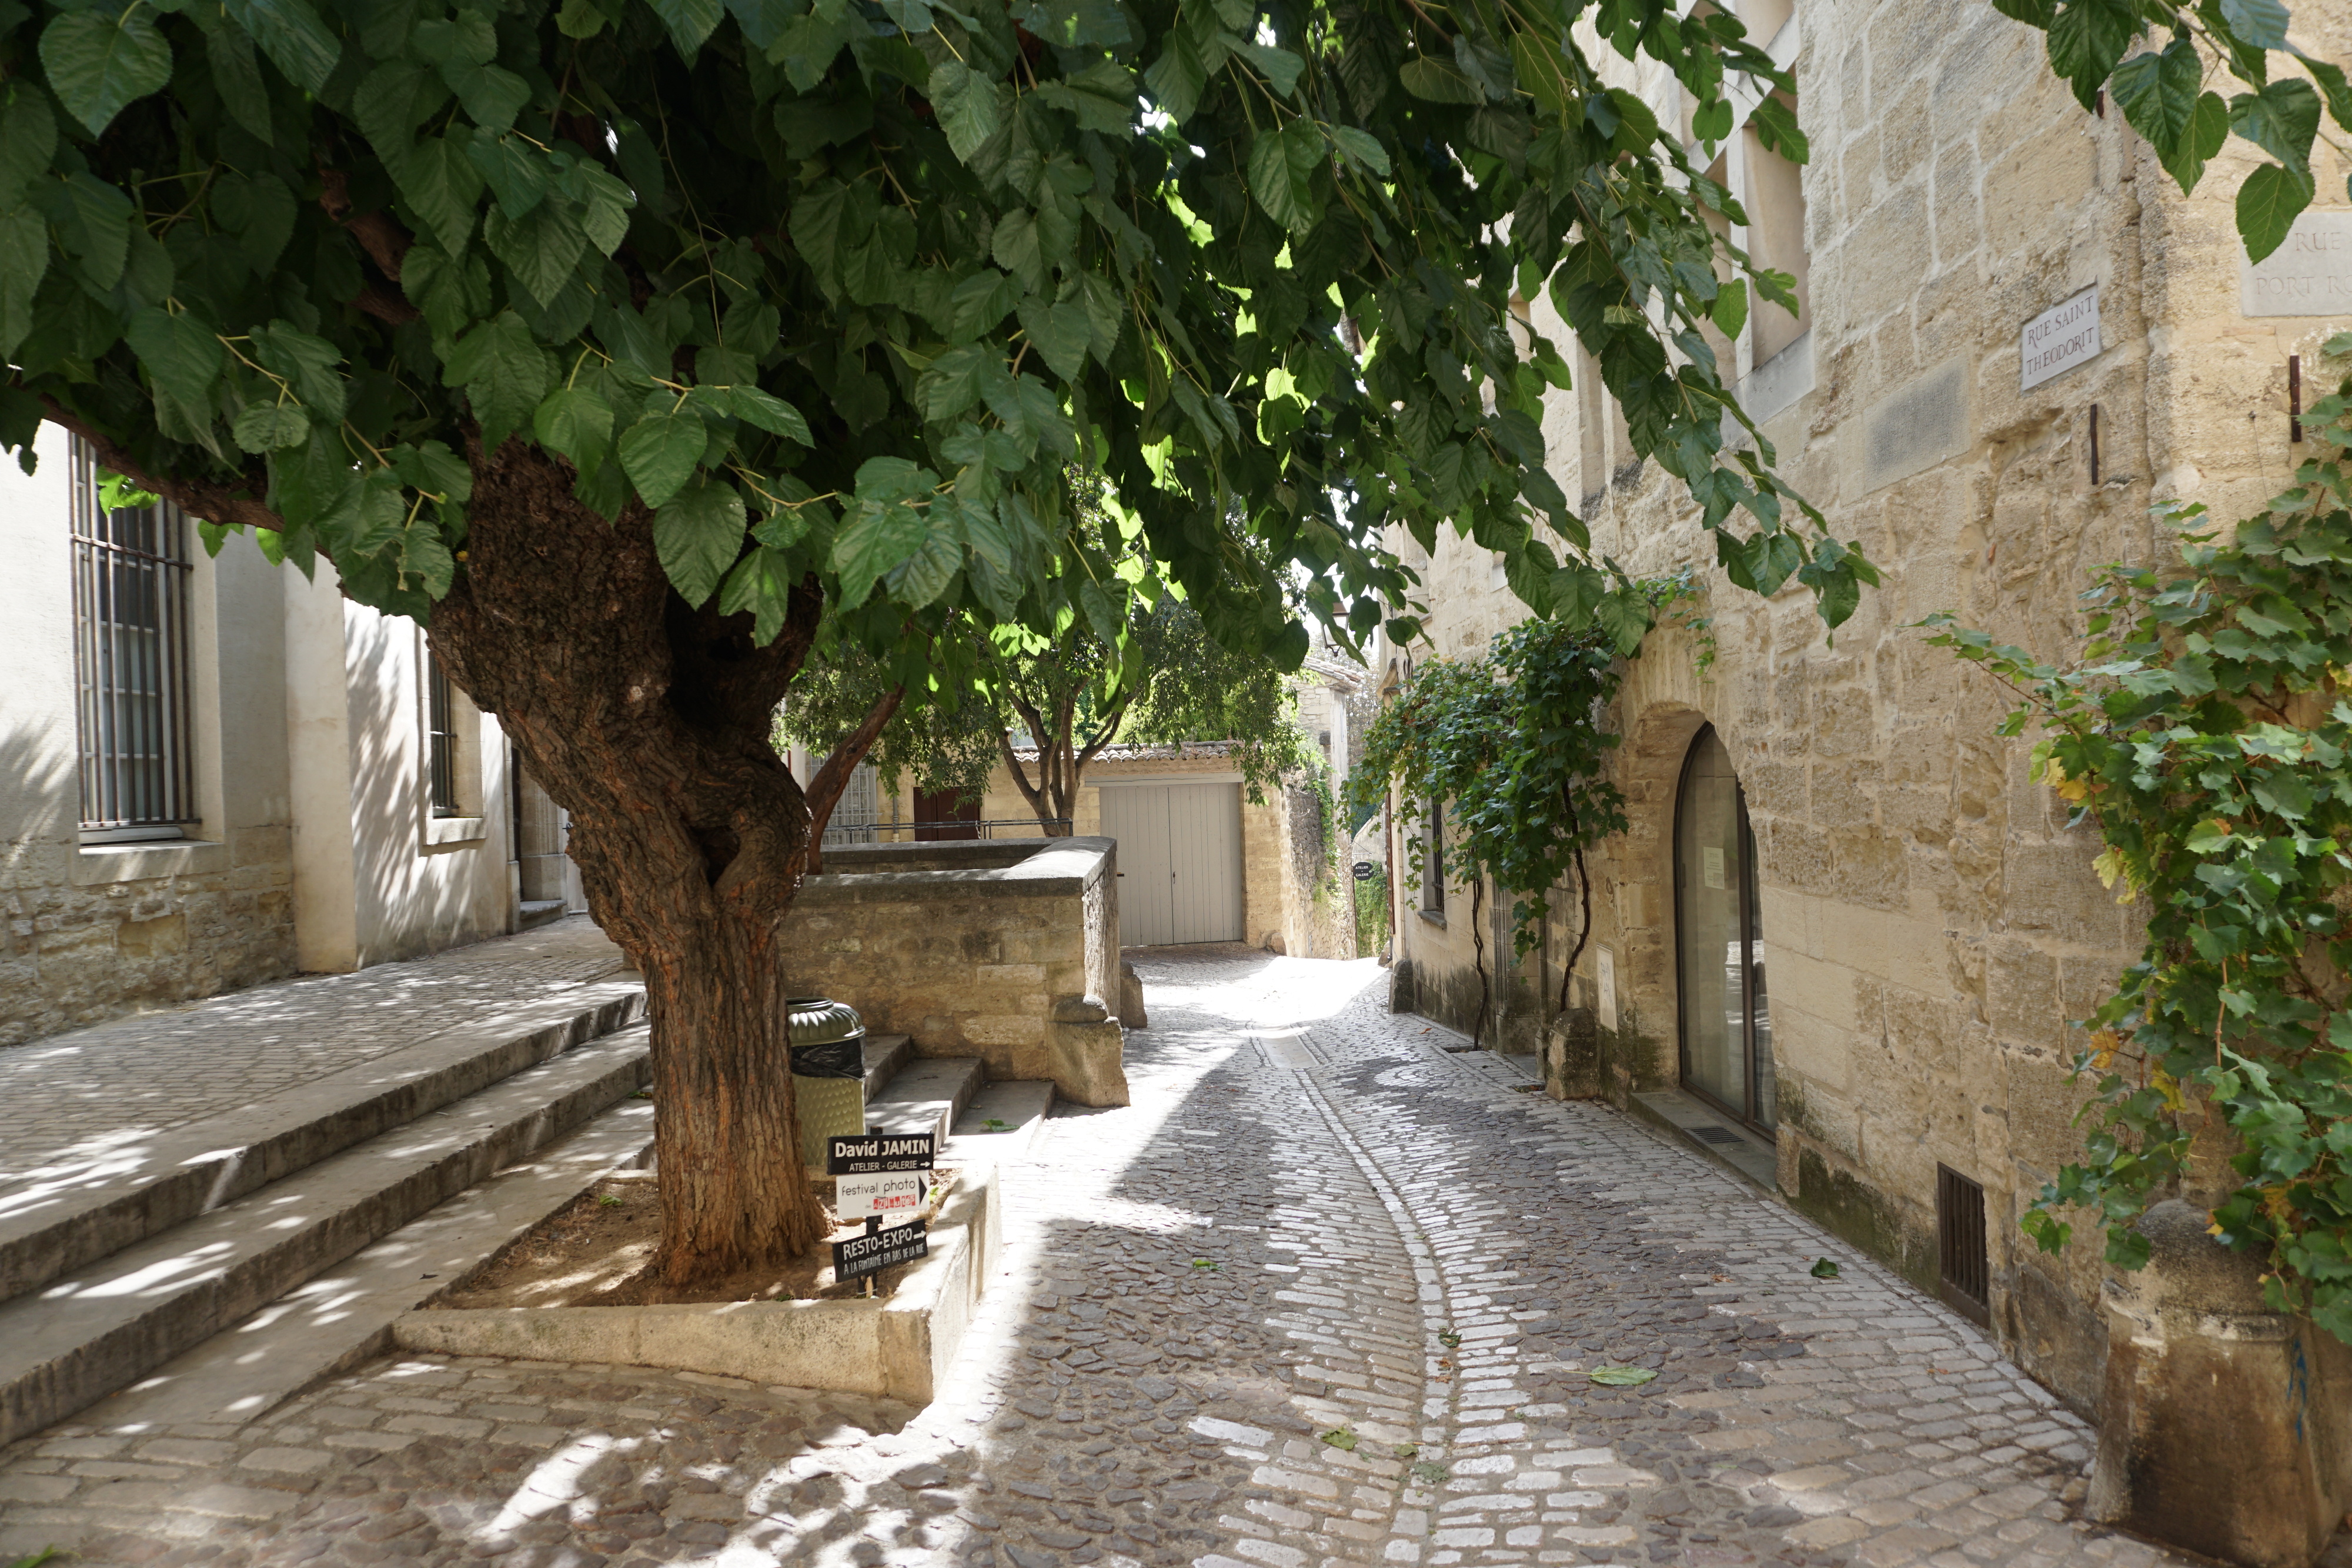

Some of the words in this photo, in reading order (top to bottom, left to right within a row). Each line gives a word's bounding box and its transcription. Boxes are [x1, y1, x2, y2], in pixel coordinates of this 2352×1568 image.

[2295, 232, 2340, 252] RUE
[2256, 276, 2314, 297] PORT
[2028, 320, 2051, 349] RUE
[2055, 295, 2093, 330] SAINT
[2027, 327, 2094, 375] THEODORIT
[835, 1141, 878, 1158] David
[881, 1139, 929, 1156] JAMIN
[849, 1162, 880, 1172] ATELIER
[887, 1160, 917, 1170] GALERIE
[842, 1182, 878, 1196] festival
[884, 1178, 916, 1195] photo
[843, 1227, 913, 1261] RESTO-EXPO
[851, 1261, 857, 1273] LA
[884, 1251, 890, 1264] EN
[892, 1248, 901, 1262] BAS
[903, 1248, 908, 1258] DE
[909, 1245, 915, 1256] LA
[916, 1243, 924, 1254] RUE
